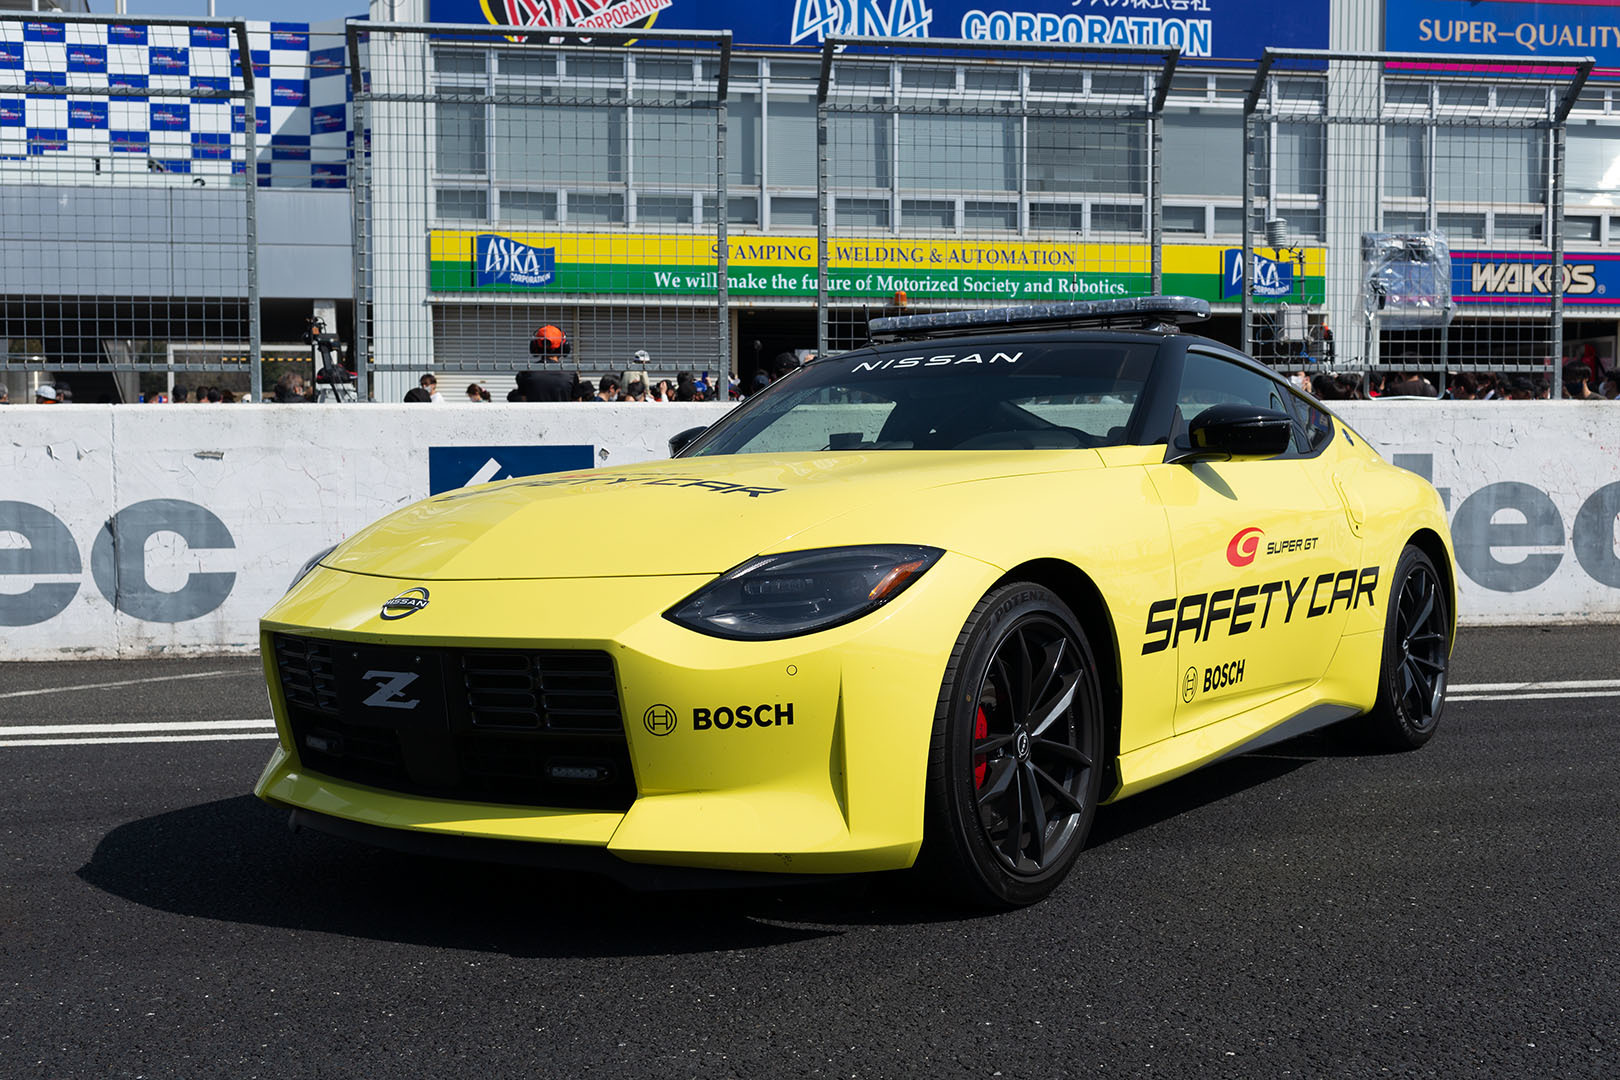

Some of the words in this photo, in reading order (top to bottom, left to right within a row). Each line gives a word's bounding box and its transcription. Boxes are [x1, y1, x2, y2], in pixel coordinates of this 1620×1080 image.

[961, 10, 1212, 57] CORPORATION
[485, 238, 540, 279] ASKA
[711, 244, 811, 261] STAMPING
[836, 246, 923, 263] WELDING
[929, 248, 942, 263] &
[948, 248, 1075, 265] AUTOMATION
[1231, 251, 1280, 288] AKA
[654, 271, 681, 288] We
[685, 272, 718, 288] will
[727, 273, 767, 289] make
[771, 274, 797, 290] the
[802, 274, 850, 290] fuure
[855, 275, 872, 291] of
[876, 275, 958, 292] Motorized
[963, 277, 1020, 297] Society
[1024, 278, 1052, 293] and
[1058, 279, 1129, 295] Robotics.
[1471, 262, 1596, 294] WAKO'S
[851, 352, 1024, 373] NISSAN
[1266, 539, 1303, 555] SUPER
[1304, 537, 1319, 551] GT
[386, 597, 428, 608] NISSAN
[1141, 576, 1310, 656] SAFETY
[1306, 566, 1380, 619] CAR
[1202, 659, 1246, 693] BOSCH
[693, 702, 794, 731] BOSCH
